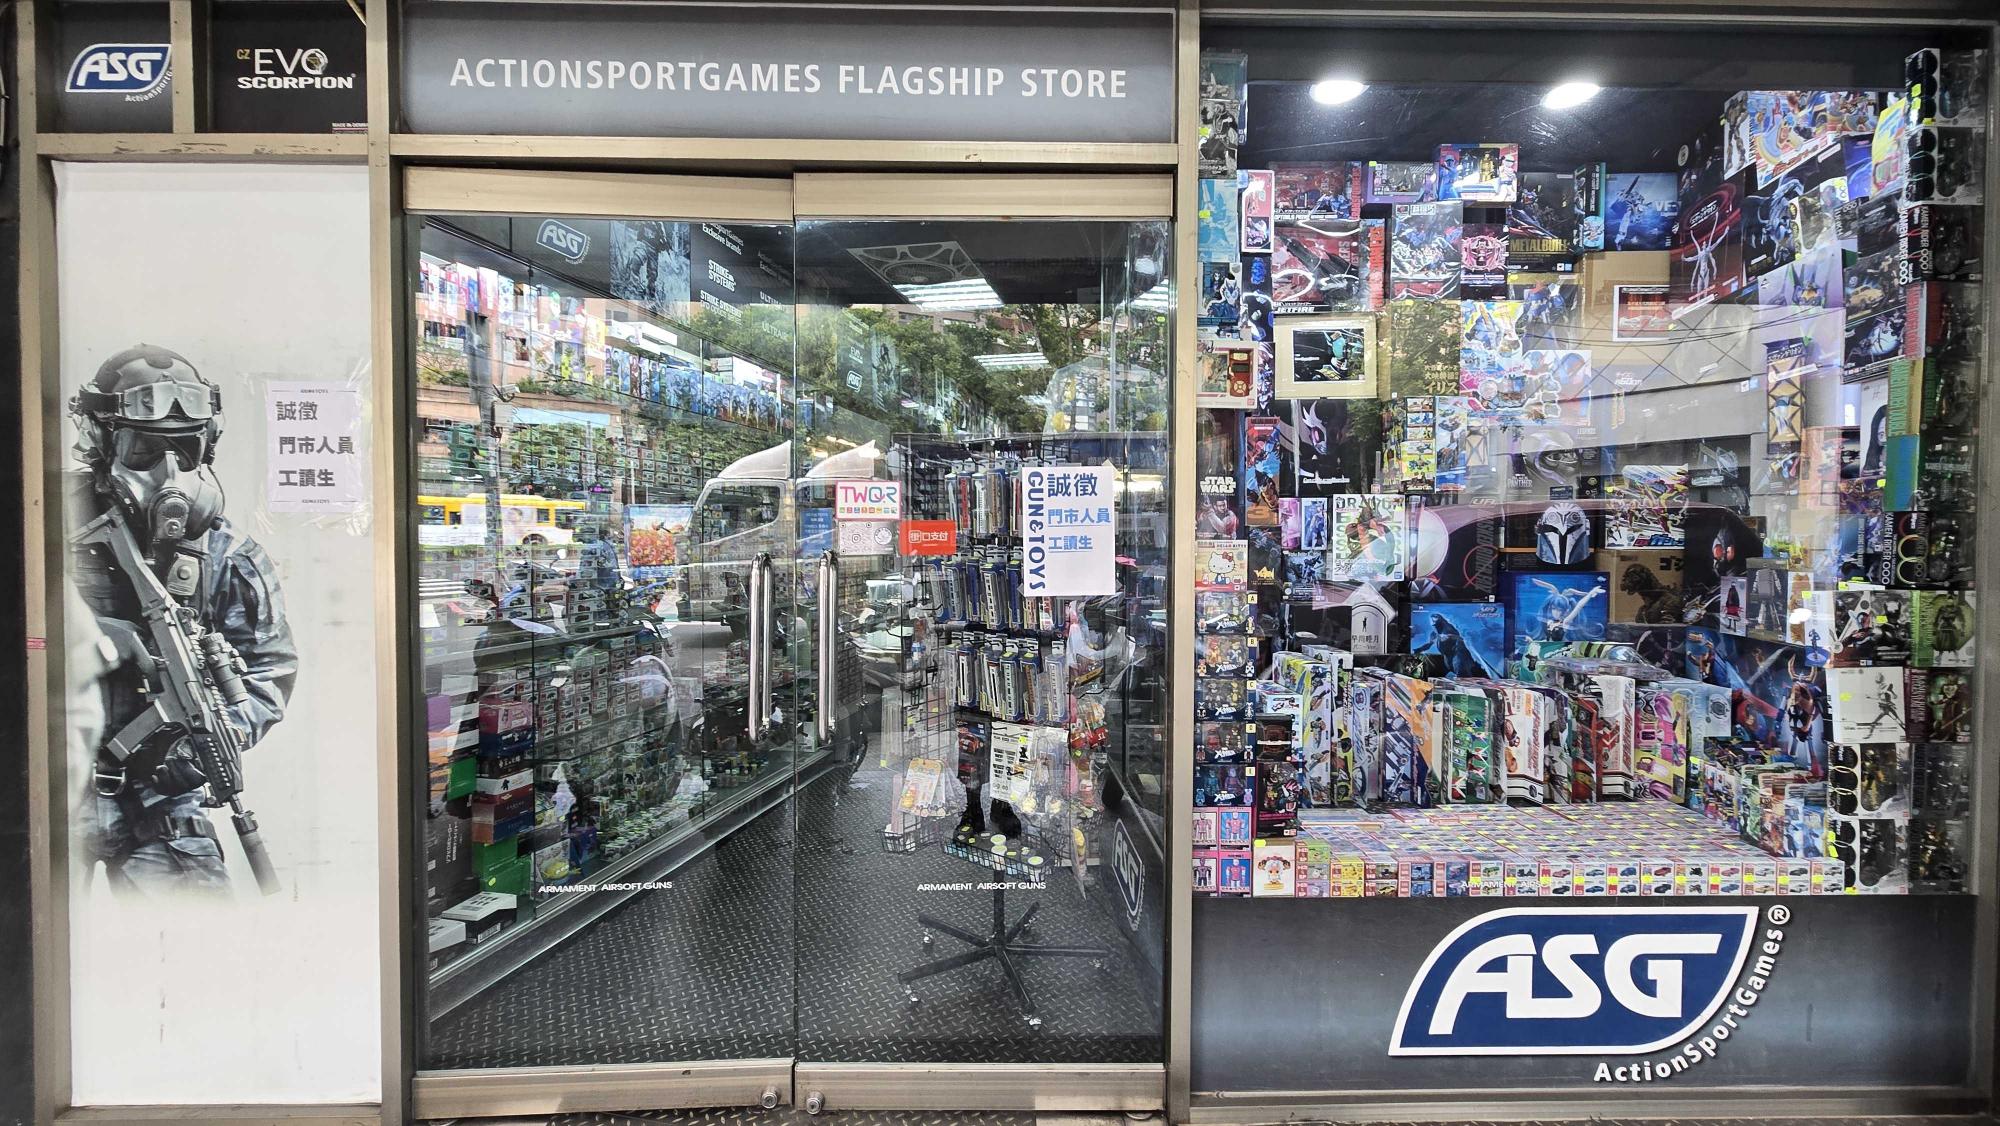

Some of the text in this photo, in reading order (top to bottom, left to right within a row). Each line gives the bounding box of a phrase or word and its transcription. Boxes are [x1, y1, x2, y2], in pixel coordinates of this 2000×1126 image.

[236, 49, 251, 60] CZ
[254, 48, 329, 75] EVO
[76, 52, 162, 86] ASG
[450, 57, 1128, 99] ACTIONSPORTGAMES FLAGSHIP STORE
[237, 76, 353, 89] SCORPION
[543, 224, 583, 254] ASG
[708, 259, 730, 278] STRIKE
[708, 270, 736, 292] SYSTEMS
[1425, 380, 1458, 394] イリス
[276, 401, 318, 421] 誠徵
[279, 436, 355, 455] 門市人員
[278, 469, 335, 487] 工讀生
[1047, 472, 1098, 498] 誠徵
[1200, 476, 1237, 485] STAR
[839, 486, 898, 505] TWQR
[1200, 484, 1237, 494] WARS
[1047, 507, 1111, 525] 門市人員
[908, 529, 949, 543] 街口支付
[1027, 471, 1046, 590] GUN&TOYS
[1048, 535, 1093, 551] 工讀生
[1881, 512, 1895, 585] KAMEN RIDER OOO
[1115, 832, 1139, 902] ASG
[538, 881, 674, 893] ARMAMENT AIRSOFT GUNS
[917, 881, 1047, 891] ARMAMENT AIRSOFT GUNS
[1428, 933, 1723, 1035] ASG
